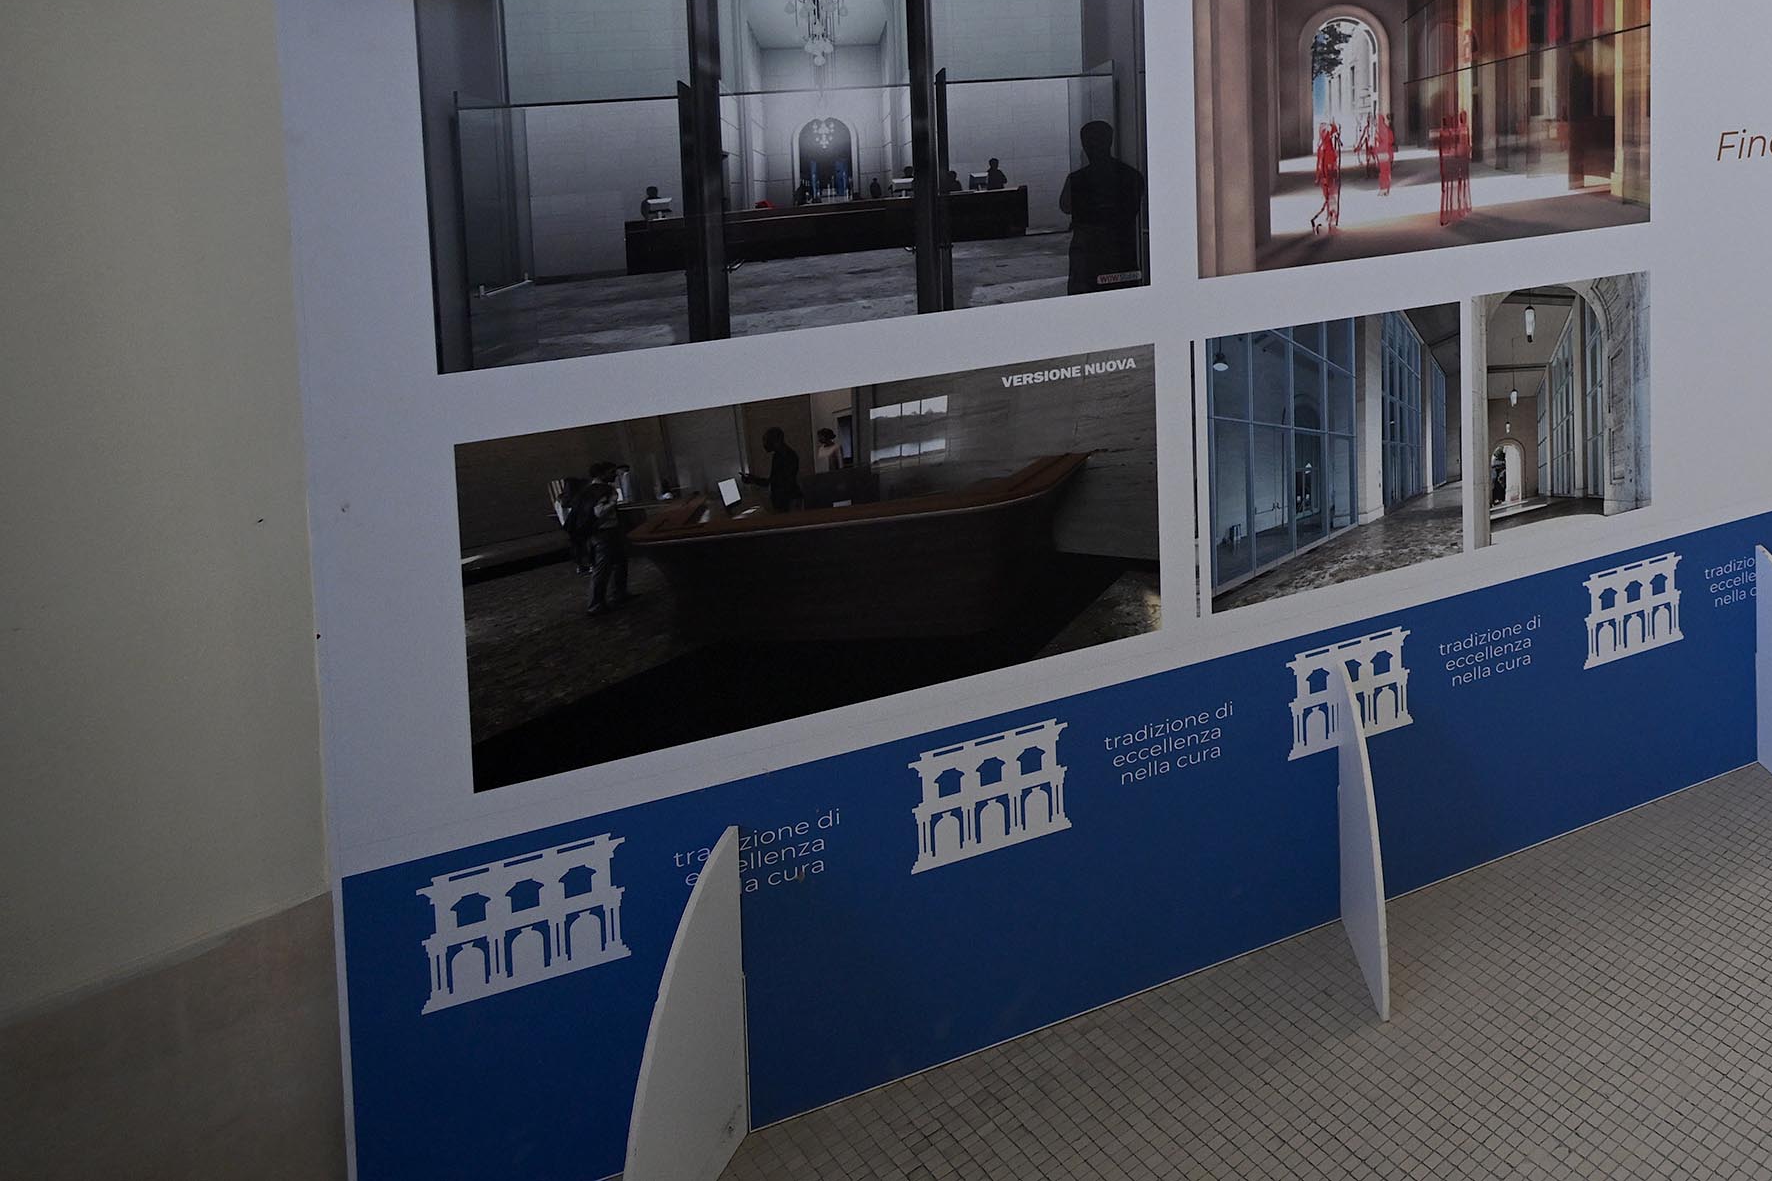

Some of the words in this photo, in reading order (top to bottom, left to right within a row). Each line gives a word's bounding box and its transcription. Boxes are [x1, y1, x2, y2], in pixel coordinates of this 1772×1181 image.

[1001, 366, 1082, 388] VERSIONE
[1084, 358, 1137, 376] NUOVA
[1704, 556, 1756, 580] tradizio
[1709, 571, 1757, 593] eccelle
[1714, 589, 1747, 607] nella
[1439, 624, 1522, 656] tradizione
[1526, 614, 1541, 631] di
[1445, 637, 1532, 671] eccellenza
[1451, 666, 1491, 687] nella
[1495, 654, 1531, 673] cura
[1104, 712, 1210, 751] tradizione
[1215, 701, 1233, 719] di
[1112, 727, 1222, 767] eccellenza
[1121, 760, 1170, 785] nella
[1176, 746, 1221, 768] cura
[673, 821, 810, 868] trazione
[817, 808, 841, 829] di
[685, 838, 825, 886] eellenza
[767, 860, 825, 886] cura
